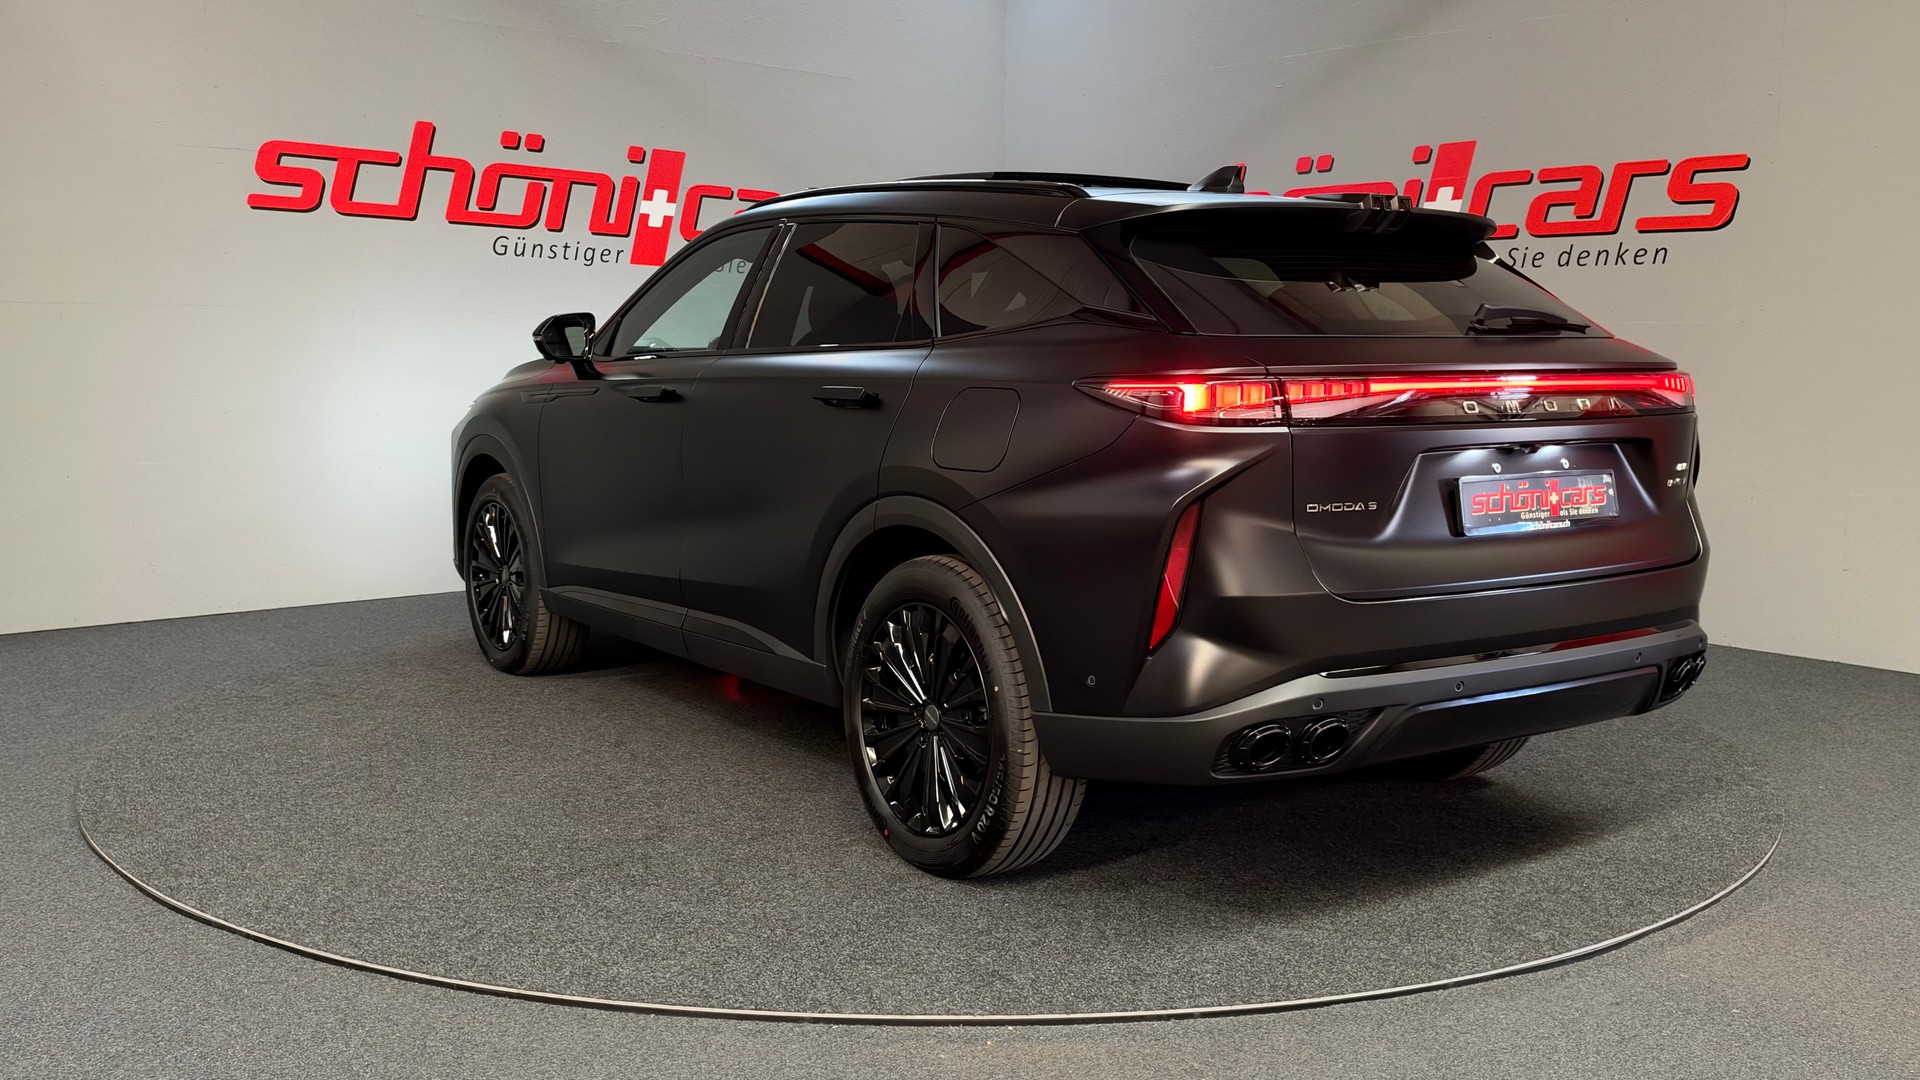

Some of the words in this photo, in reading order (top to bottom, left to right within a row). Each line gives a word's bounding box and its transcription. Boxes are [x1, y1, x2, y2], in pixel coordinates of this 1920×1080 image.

[491, 235, 625, 267] Günstiger
[1507, 245, 1545, 269] Sie
[1557, 241, 1669, 268] denken
[1306, 502, 1365, 512] OMODA
[1520, 511, 1551, 520] Günstiger
[1569, 507, 1578, 515] Sie
